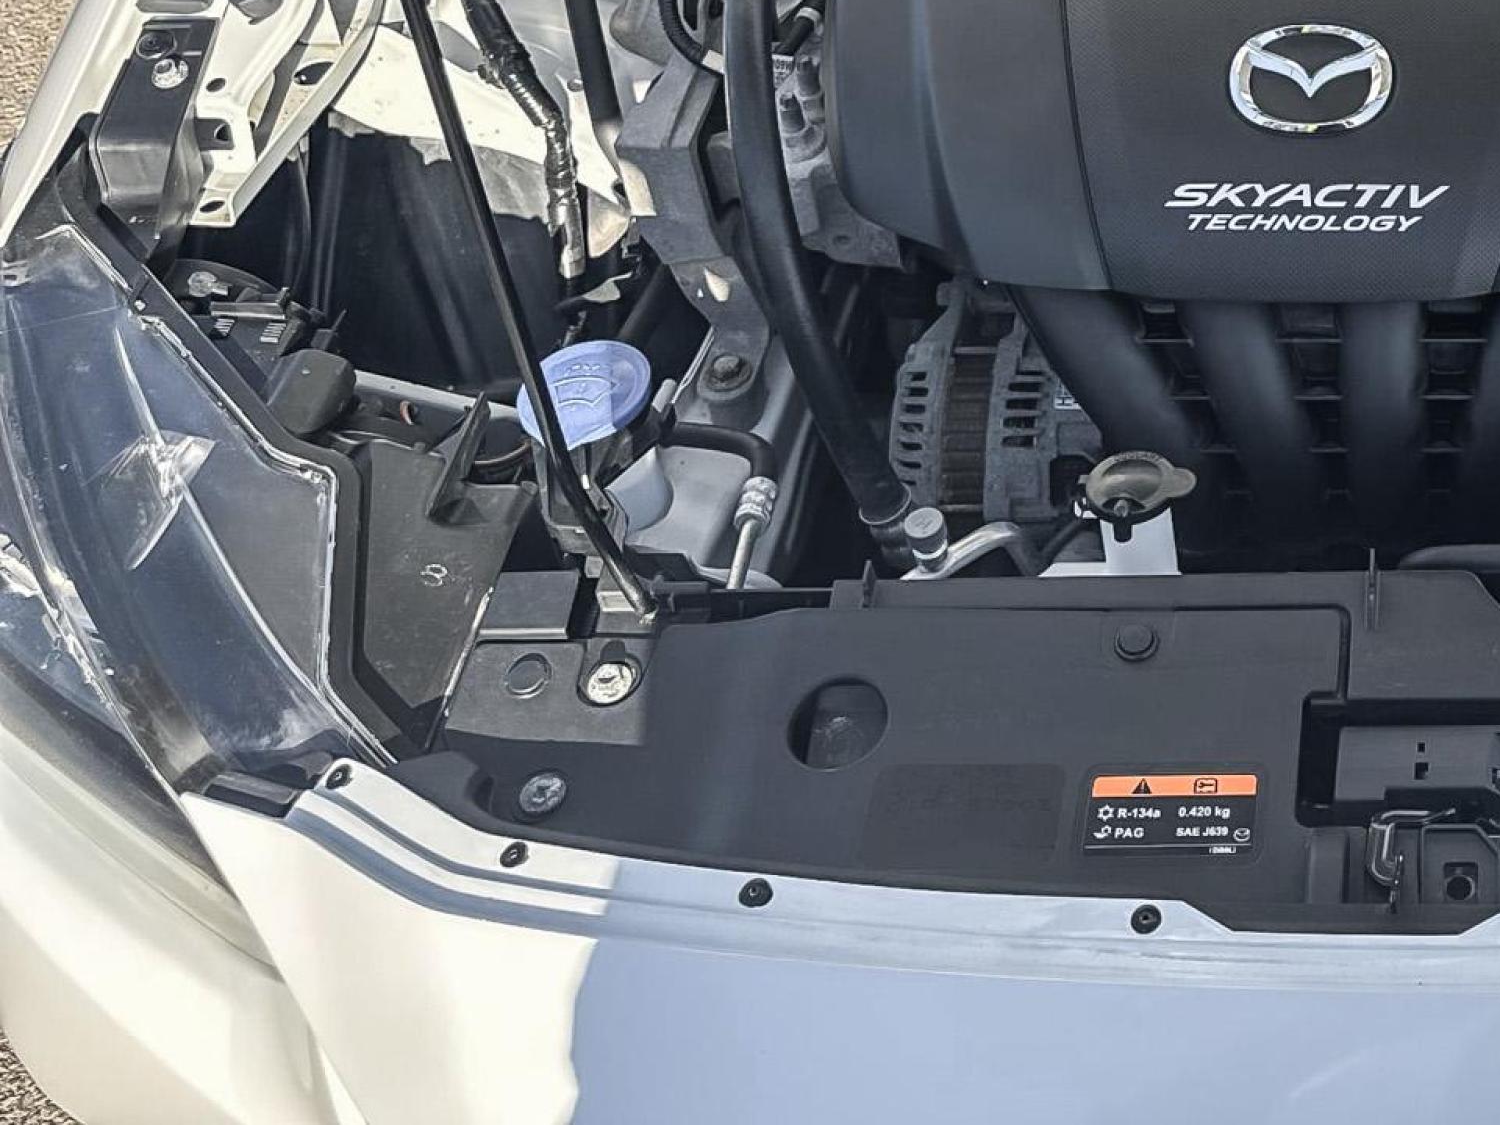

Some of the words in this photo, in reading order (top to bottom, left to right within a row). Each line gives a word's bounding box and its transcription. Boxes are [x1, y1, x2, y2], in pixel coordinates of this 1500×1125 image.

[1164, 183, 1450, 209] SKYACTIV
[1186, 213, 1423, 232] TECHNOLOGY
[1116, 807, 1161, 819] R-134a
[1178, 805, 1212, 818] 0.420
[1215, 805, 1231, 820] kg
[1114, 827, 1145, 839] PAG
[1176, 827, 1201, 837] SAE
